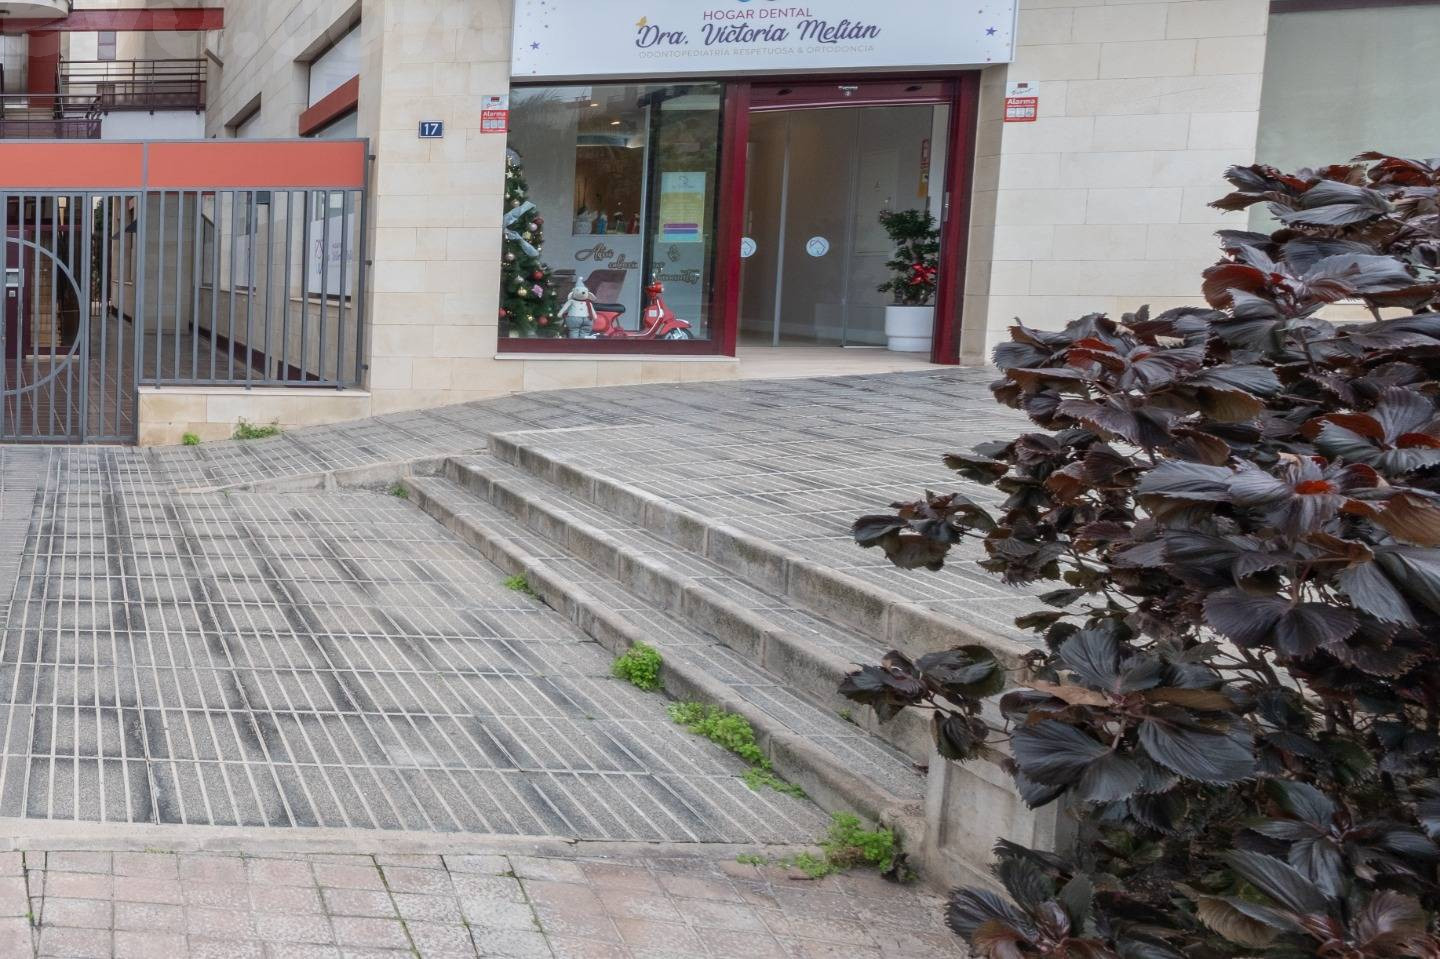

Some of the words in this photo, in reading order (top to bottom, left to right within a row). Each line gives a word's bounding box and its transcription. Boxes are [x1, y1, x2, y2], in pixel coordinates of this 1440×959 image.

[703, 8, 754, 21] HOGAR
[759, 7, 813, 19] DENTAL
[635, 24, 689, 48] Dra.
[701, 21, 790, 46] Victoria
[797, 18, 882, 44] Melián
[807, 44, 875, 54] ORTODONCIA
[424, 123, 439, 136] 17
